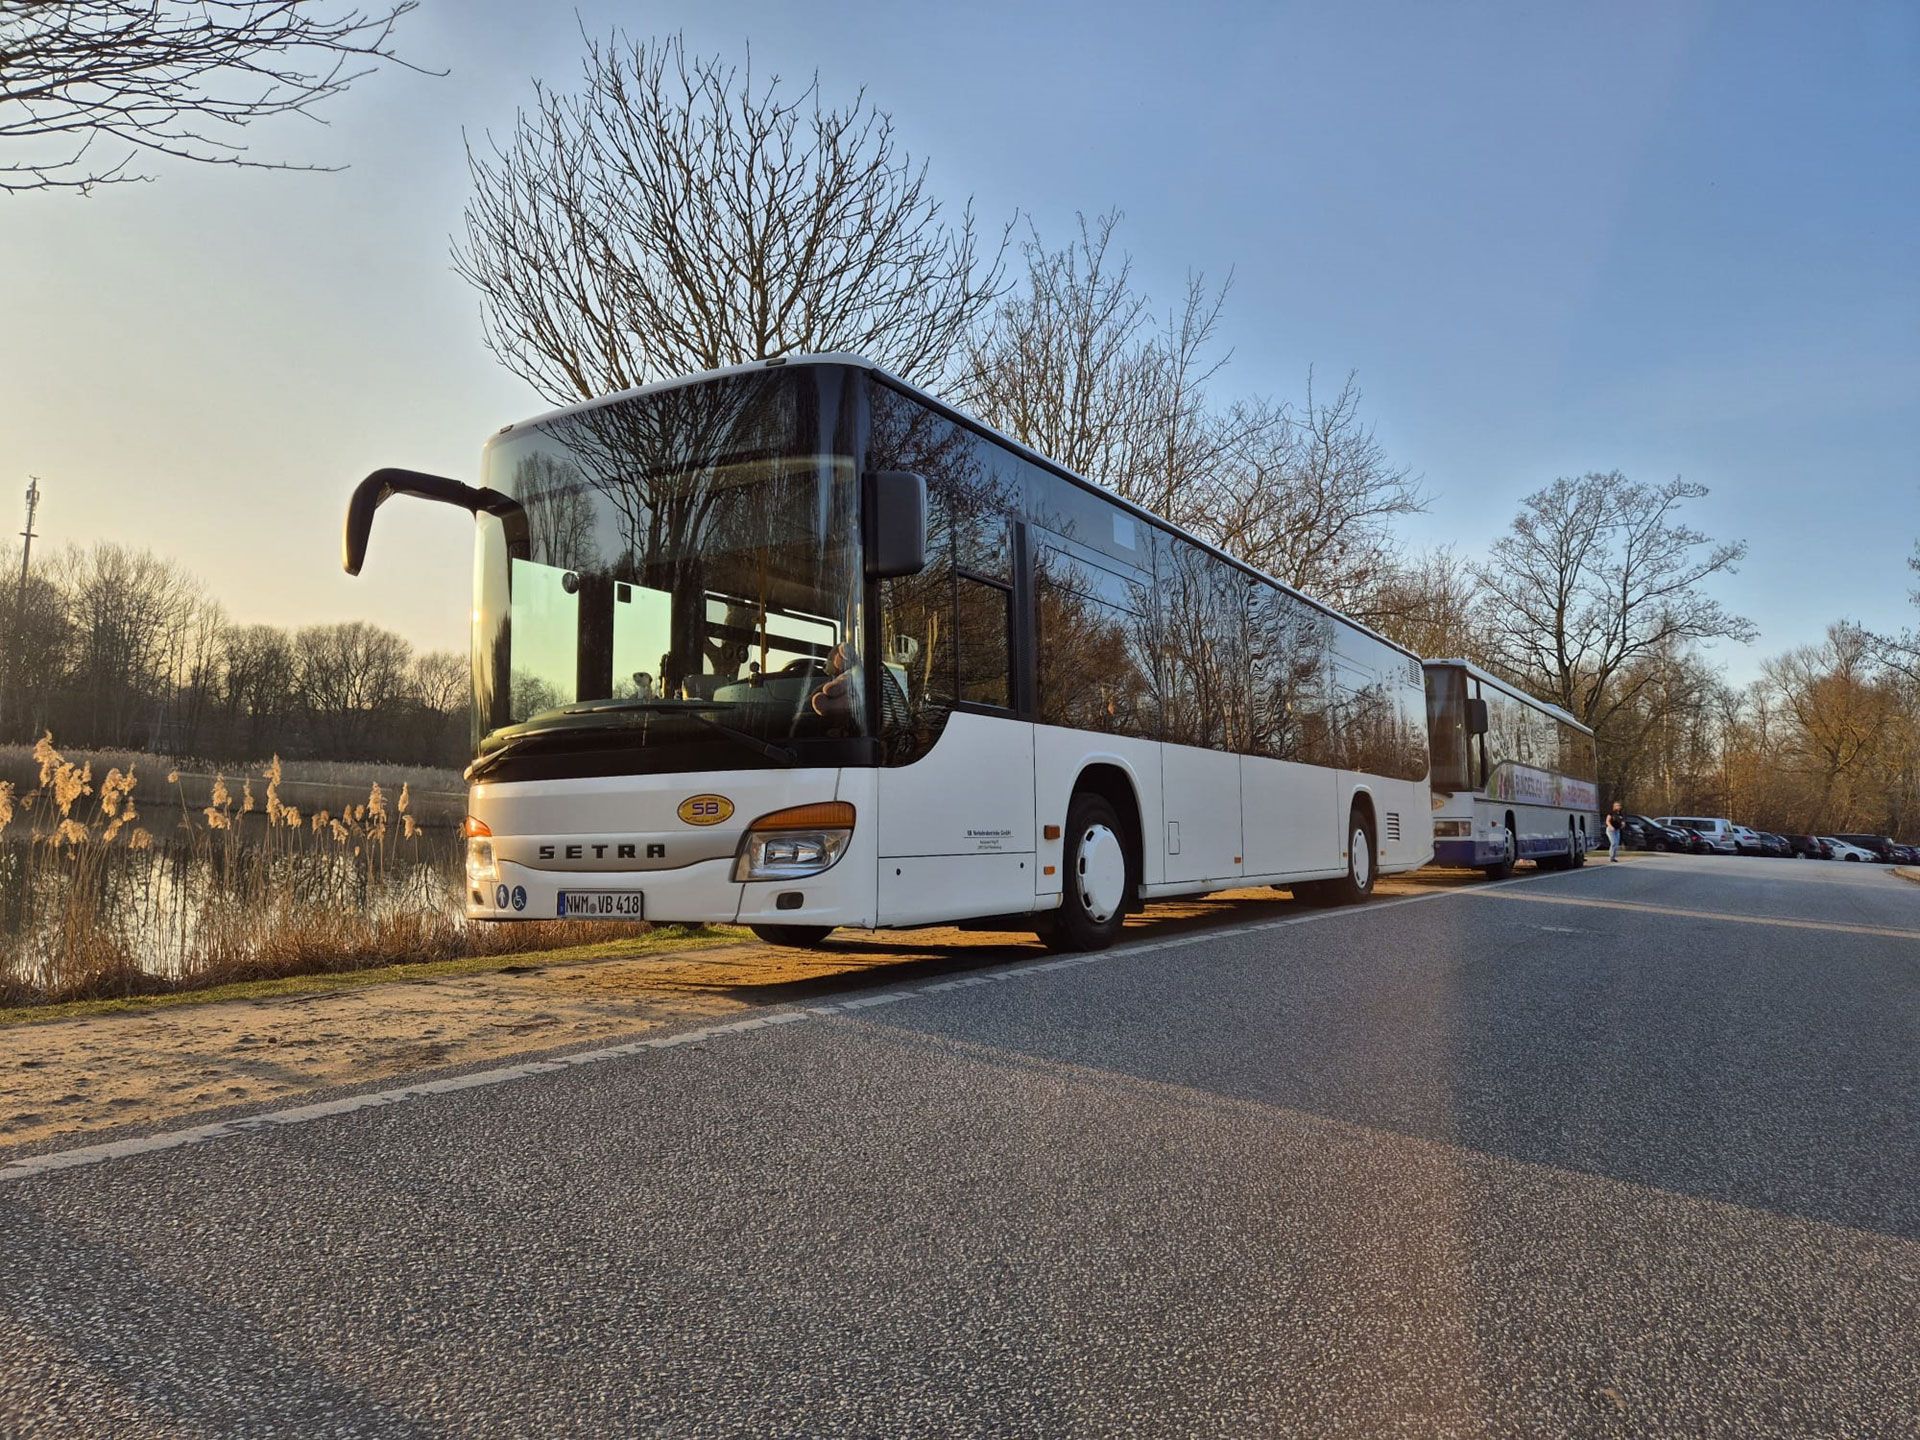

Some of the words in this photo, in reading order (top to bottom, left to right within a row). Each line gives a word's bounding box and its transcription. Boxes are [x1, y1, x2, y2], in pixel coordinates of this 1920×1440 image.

[692, 802, 719, 816] SB
[539, 844, 666, 860] SETRA
[566, 895, 589, 914] NWM
[598, 895, 613, 914] VB
[616, 895, 640, 914] 418
